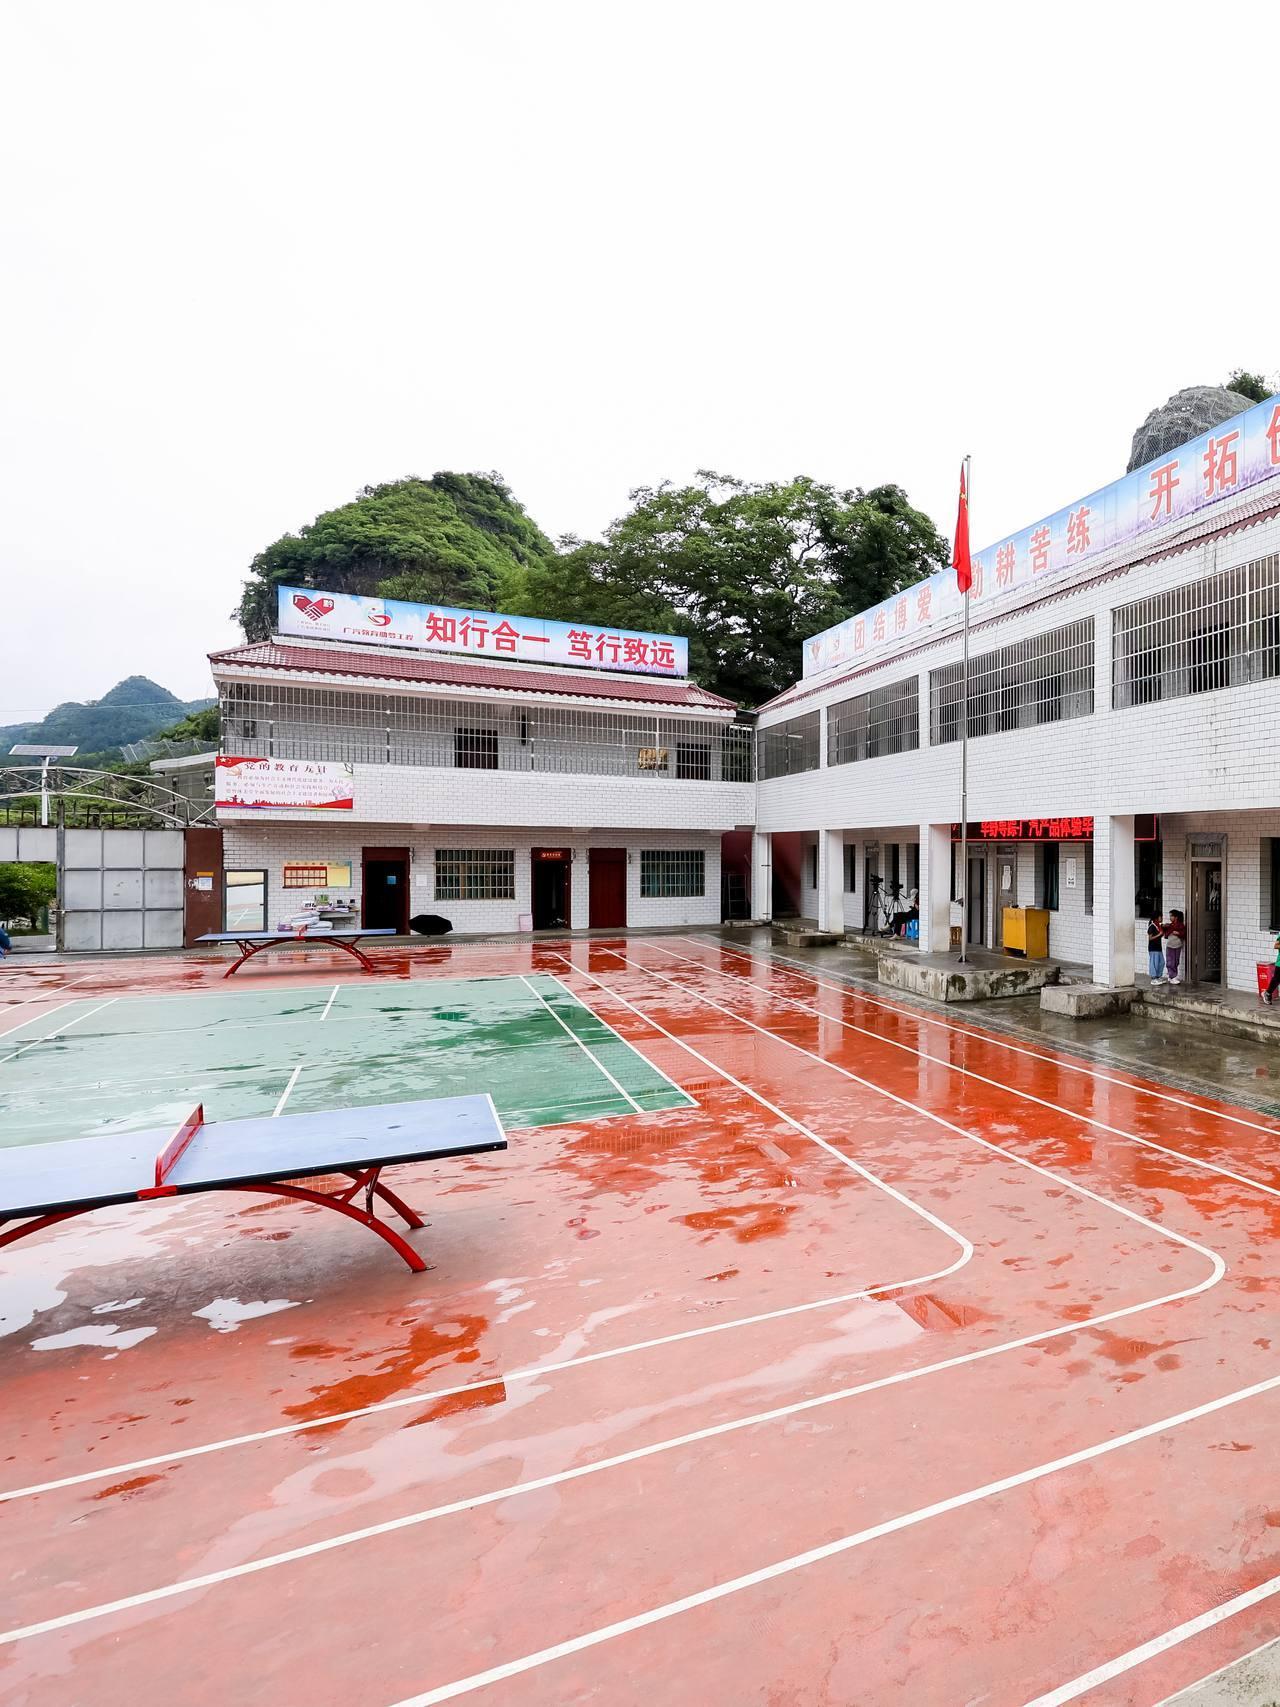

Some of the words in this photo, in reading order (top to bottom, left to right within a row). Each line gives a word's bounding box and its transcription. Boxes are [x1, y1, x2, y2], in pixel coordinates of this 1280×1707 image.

[425, 611, 550, 653] 知行合一
[566, 629, 675, 669] 笃行致远
[855, 583, 932, 652] 团结博爱
